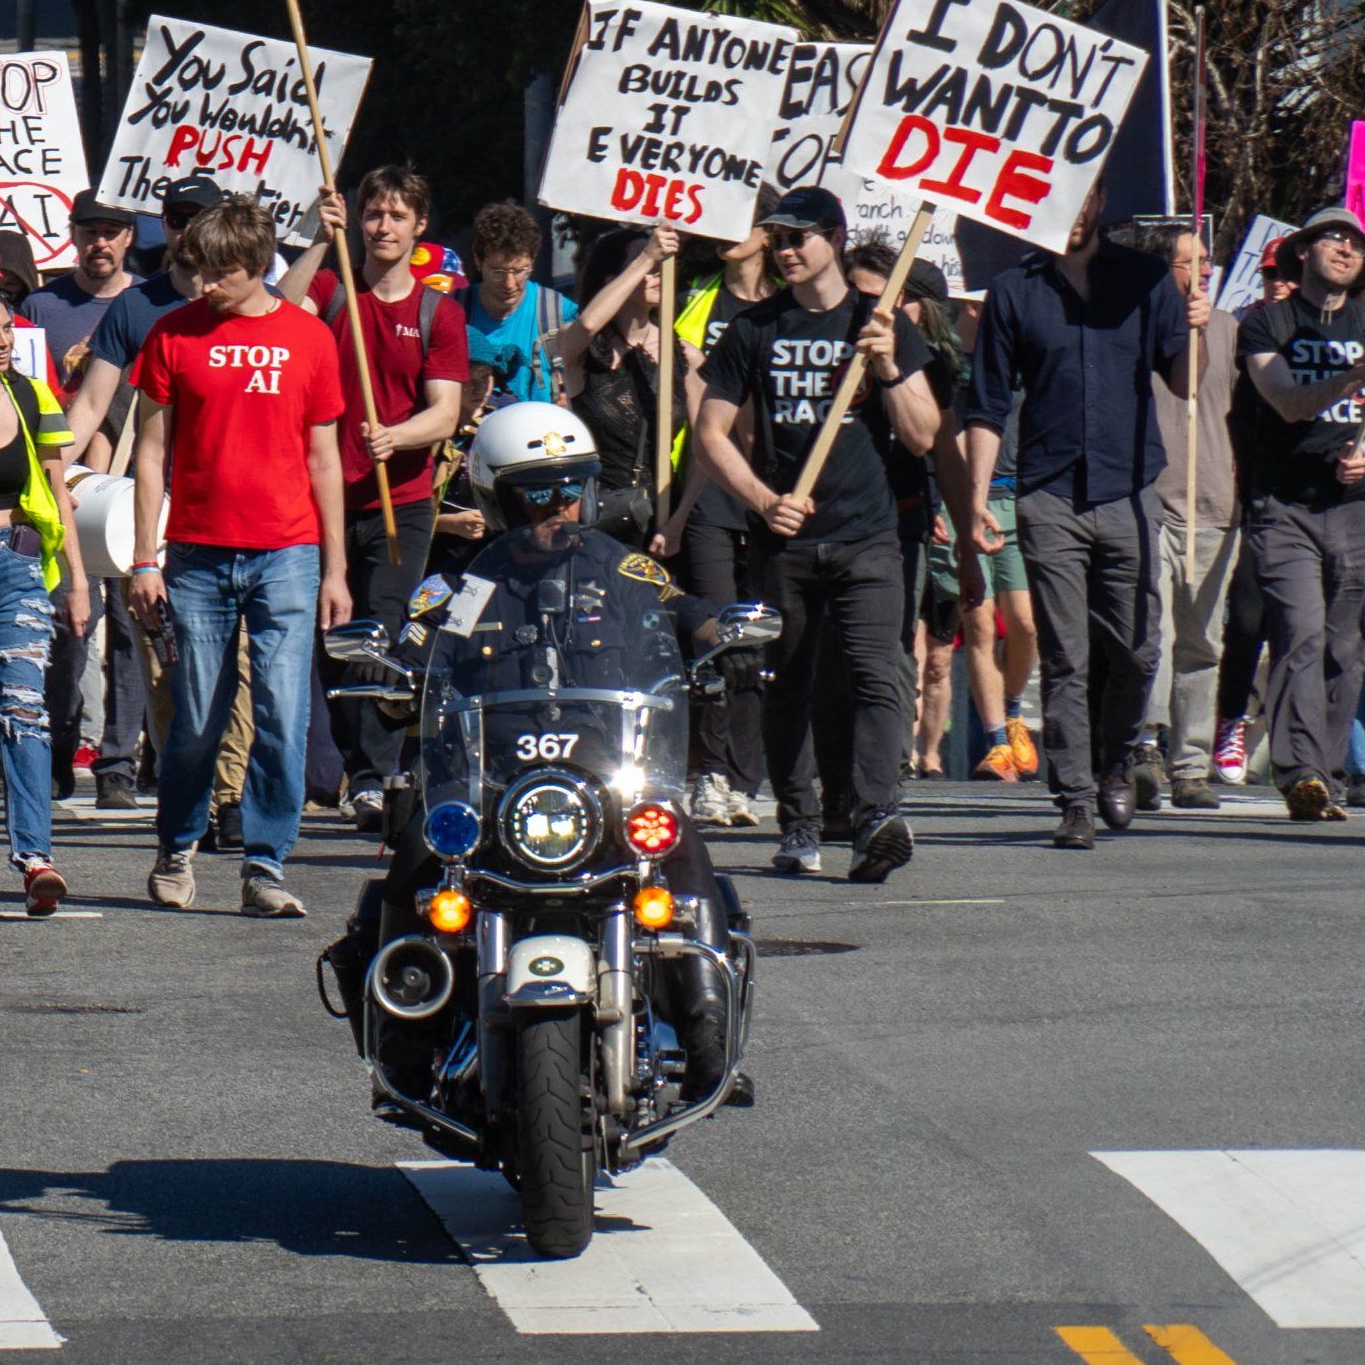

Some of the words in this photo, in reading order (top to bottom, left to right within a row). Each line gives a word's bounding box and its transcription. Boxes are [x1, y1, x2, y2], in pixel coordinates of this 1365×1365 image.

[587, 8, 642, 53] IF
[648, 17, 795, 75] ANYONE
[977, 1, 1136, 109] DON'T
[152, 25, 226, 91] You
[228, 40, 325, 105] Said
[618, 63, 744, 106] BUILDS
[779, 44, 871, 120] EAS
[127, 82, 190, 129] You
[642, 103, 691, 136] IT
[163, 124, 273, 175] PUSH
[119, 156, 171, 202] The
[875, 113, 1055, 231] DIE
[611, 167, 706, 224] DIES
[208, 345, 290, 368] STOP
[772, 339, 854, 366] STOP
[1292, 339, 1363, 365] STOP
[244, 370, 282, 394] AI
[770, 370, 833, 397] THE
[1322, 399, 1363, 423] ACE
[517, 734, 580, 761] 367
